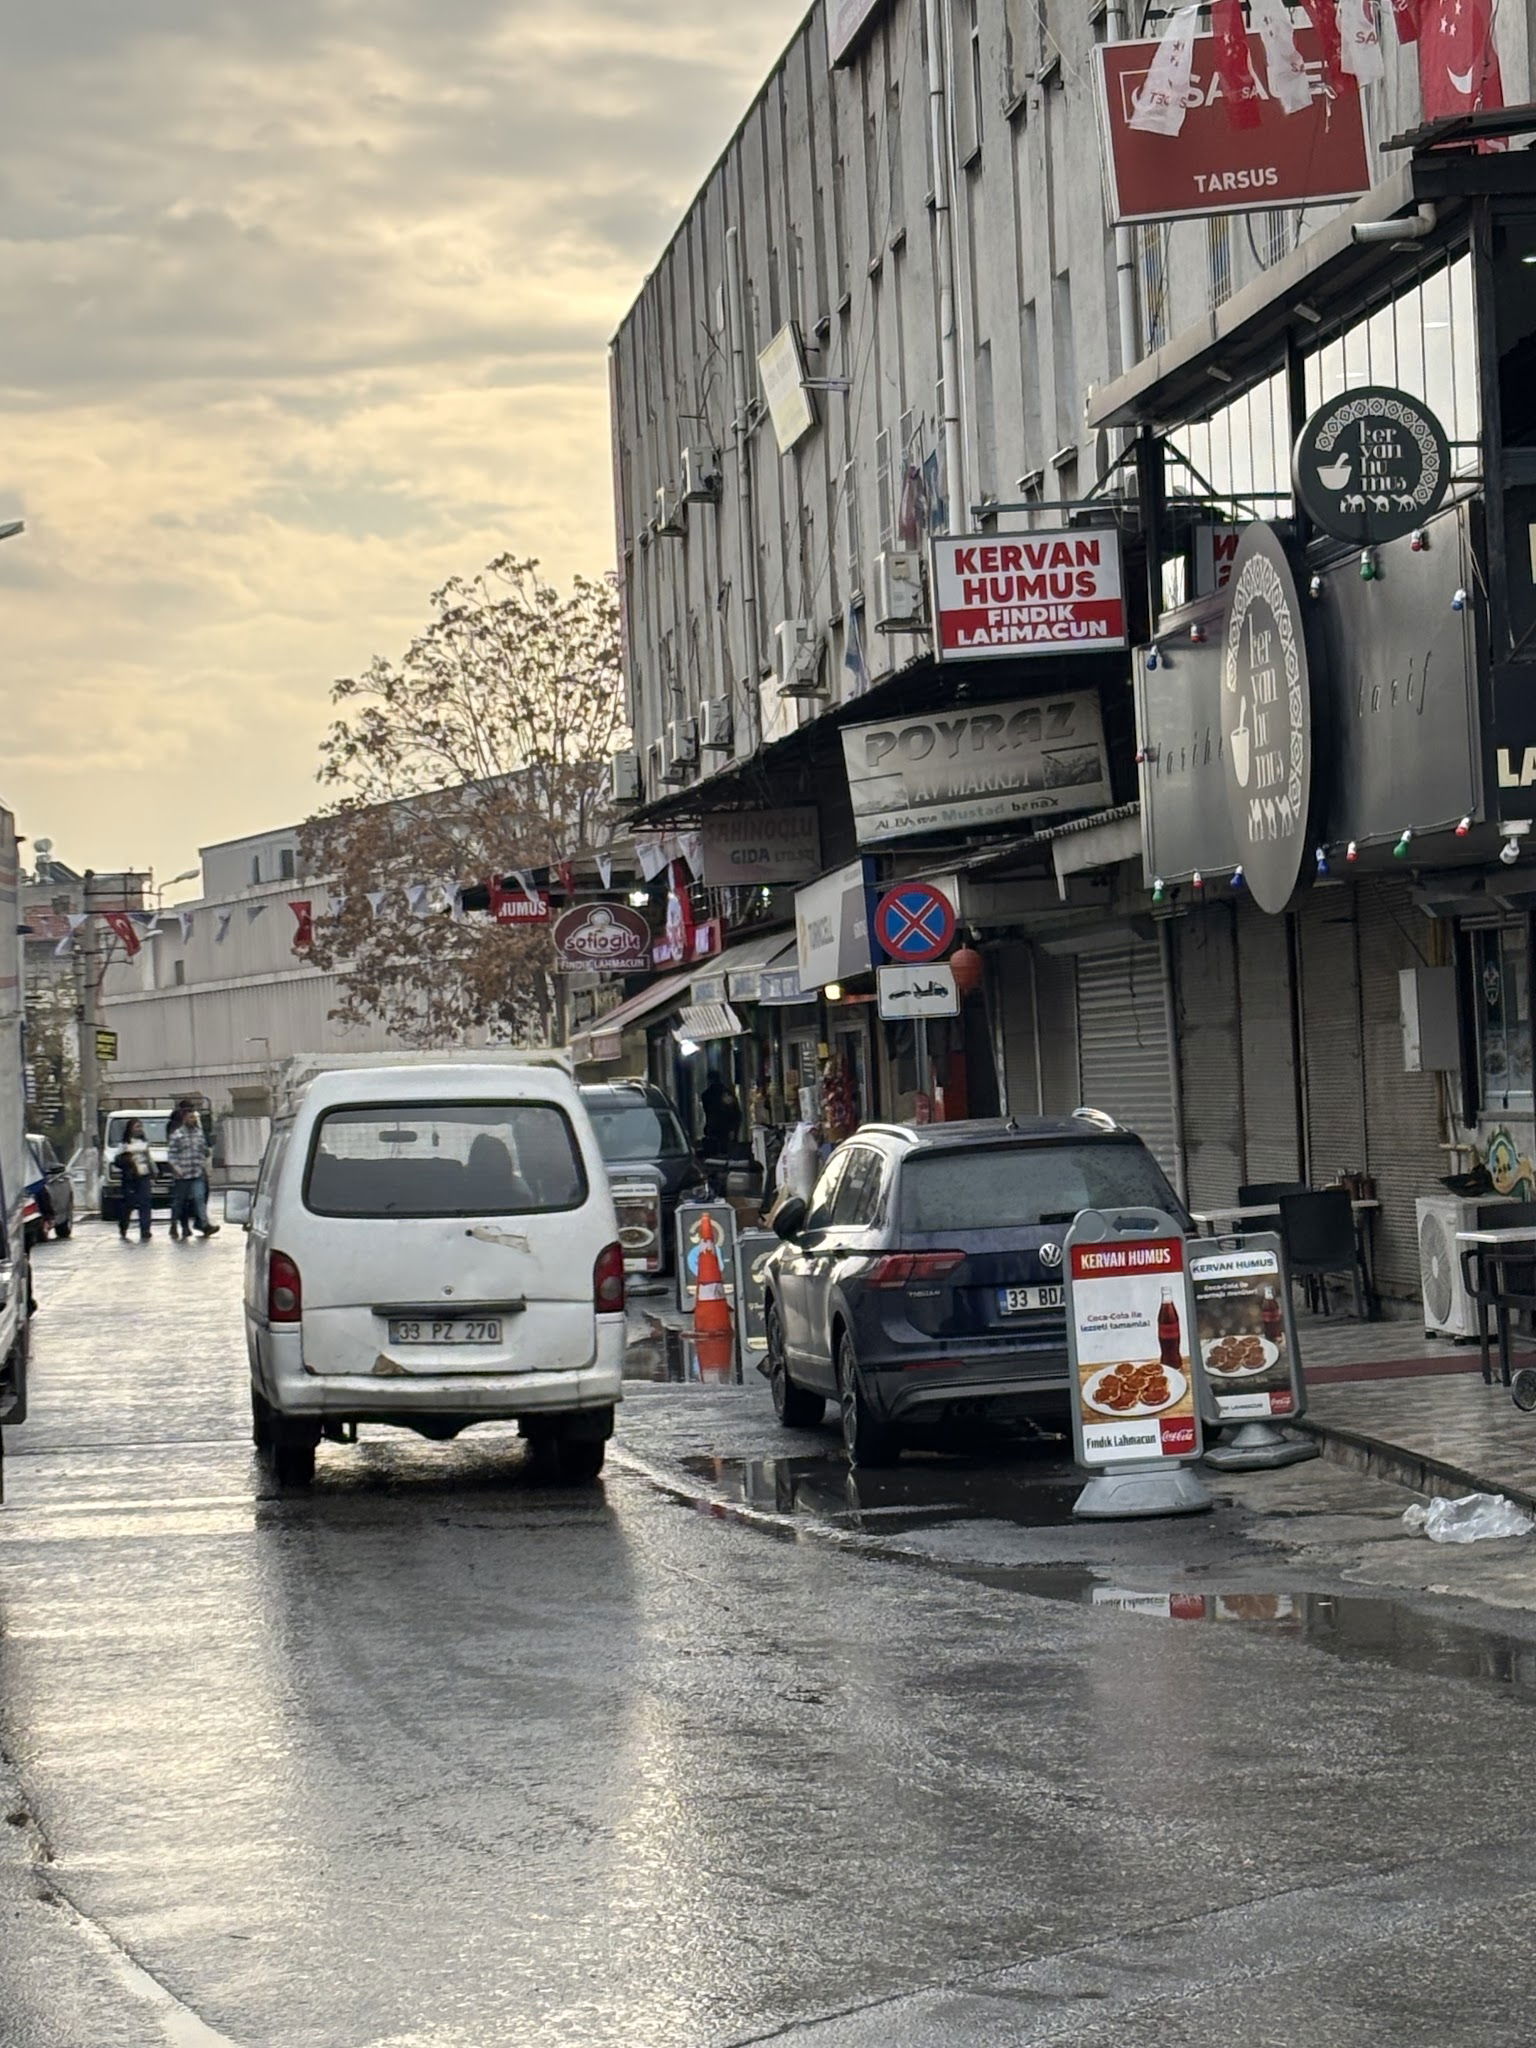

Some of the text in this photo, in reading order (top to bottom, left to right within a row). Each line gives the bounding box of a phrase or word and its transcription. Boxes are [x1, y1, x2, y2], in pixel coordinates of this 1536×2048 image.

[1193, 168, 1278, 193] TARSUS
[954, 539, 1100, 575] KERVAN
[963, 571, 1097, 605] HUMUS
[987, 604, 1075, 626] FINDIK
[957, 620, 1108, 646] LAHMACUN
[864, 701, 1078, 768] POYRAZ
[947, 766, 1031, 797] MARKET
[730, 847, 770, 865] GIDA
[498, 900, 547, 918] HUMUS
[1081, 1247, 1171, 1270] KERVAN HUMUS
[1192, 1258, 1274, 1274] KERVAN HUMUS
[1009, 1289, 1028, 1308] 33
[400, 1321, 498, 1340] 33 PZ 270
[1114, 1434, 1157, 1447] Lahmacun
